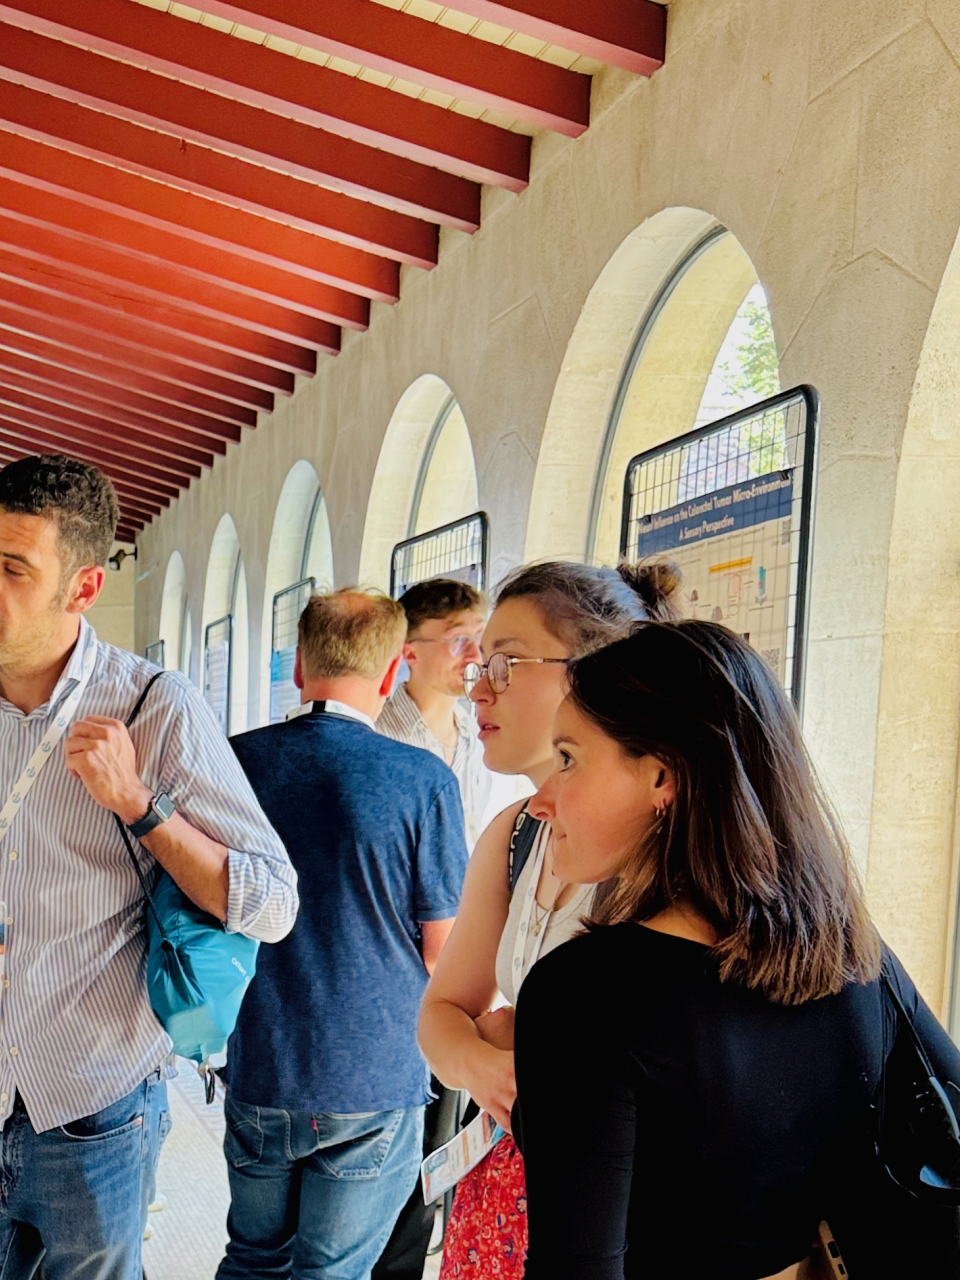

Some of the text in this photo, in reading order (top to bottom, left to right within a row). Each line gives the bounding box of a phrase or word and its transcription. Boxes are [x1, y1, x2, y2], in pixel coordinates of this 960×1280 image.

[714, 496, 732, 509] Tumor
[679, 528, 684, 541] A
[684, 525, 702, 540] Sensory
[702, 516, 734, 533] Perspective
